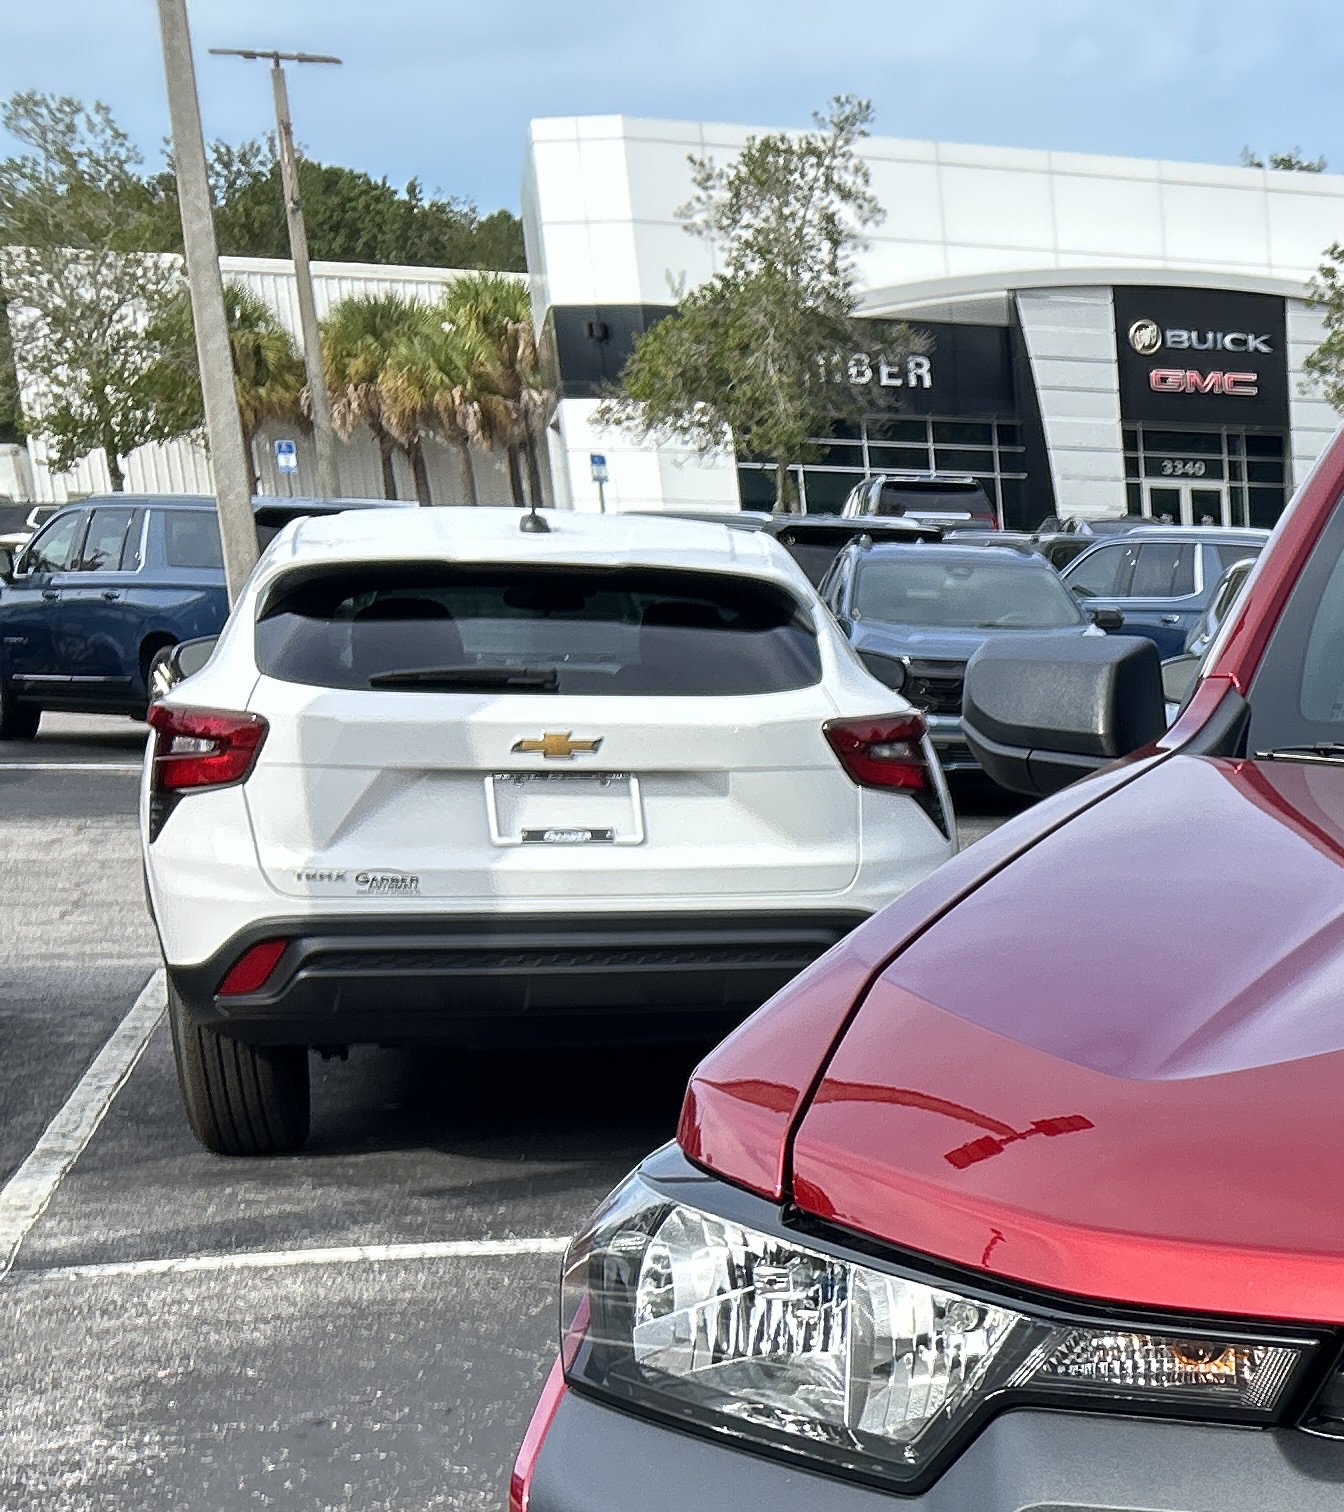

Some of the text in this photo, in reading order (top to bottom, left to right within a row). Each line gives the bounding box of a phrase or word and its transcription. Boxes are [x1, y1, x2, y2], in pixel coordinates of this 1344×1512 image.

[1165, 328, 1274, 354] BUICK
[812, 351, 933, 389] BER
[1150, 368, 1258, 396] GMC
[1161, 459, 1206, 476] 3340
